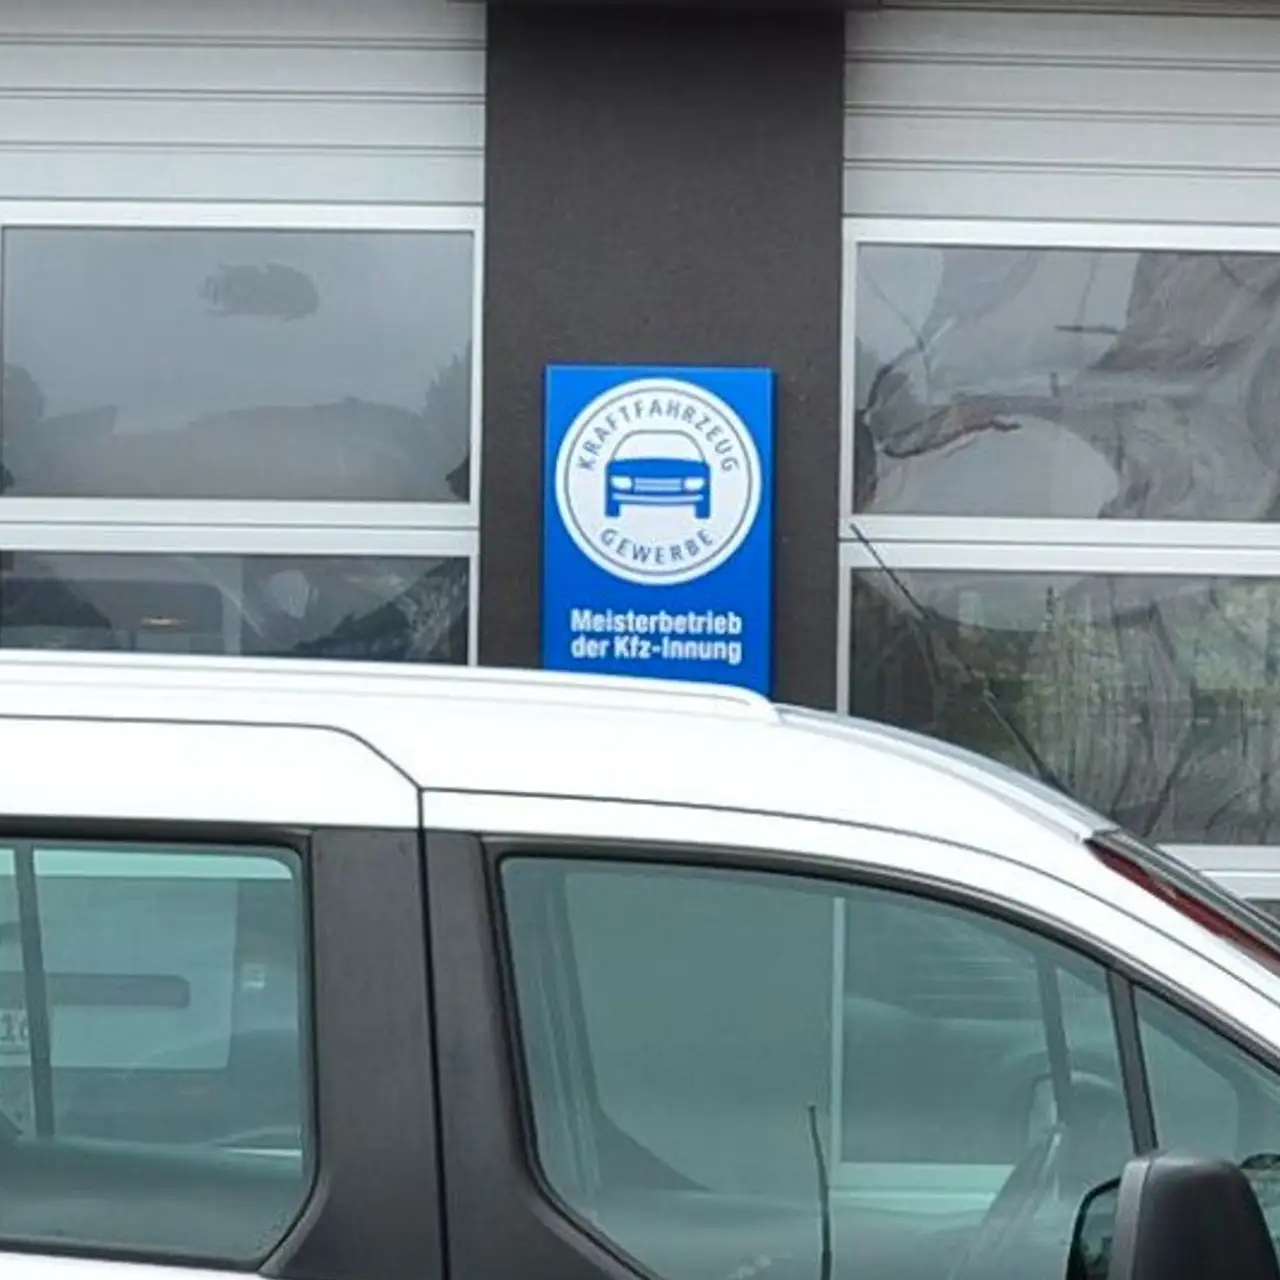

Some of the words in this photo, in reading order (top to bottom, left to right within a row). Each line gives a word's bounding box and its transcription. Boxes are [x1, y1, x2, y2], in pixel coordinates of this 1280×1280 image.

[577, 398, 740, 472] KRAFTFAHRZEUG
[600, 528, 712, 565] GEWERBE
[570, 608, 742, 635] Meisterbetrieb
[570, 635, 609, 659] der
[614, 635, 742, 666] Kfz-Innung
